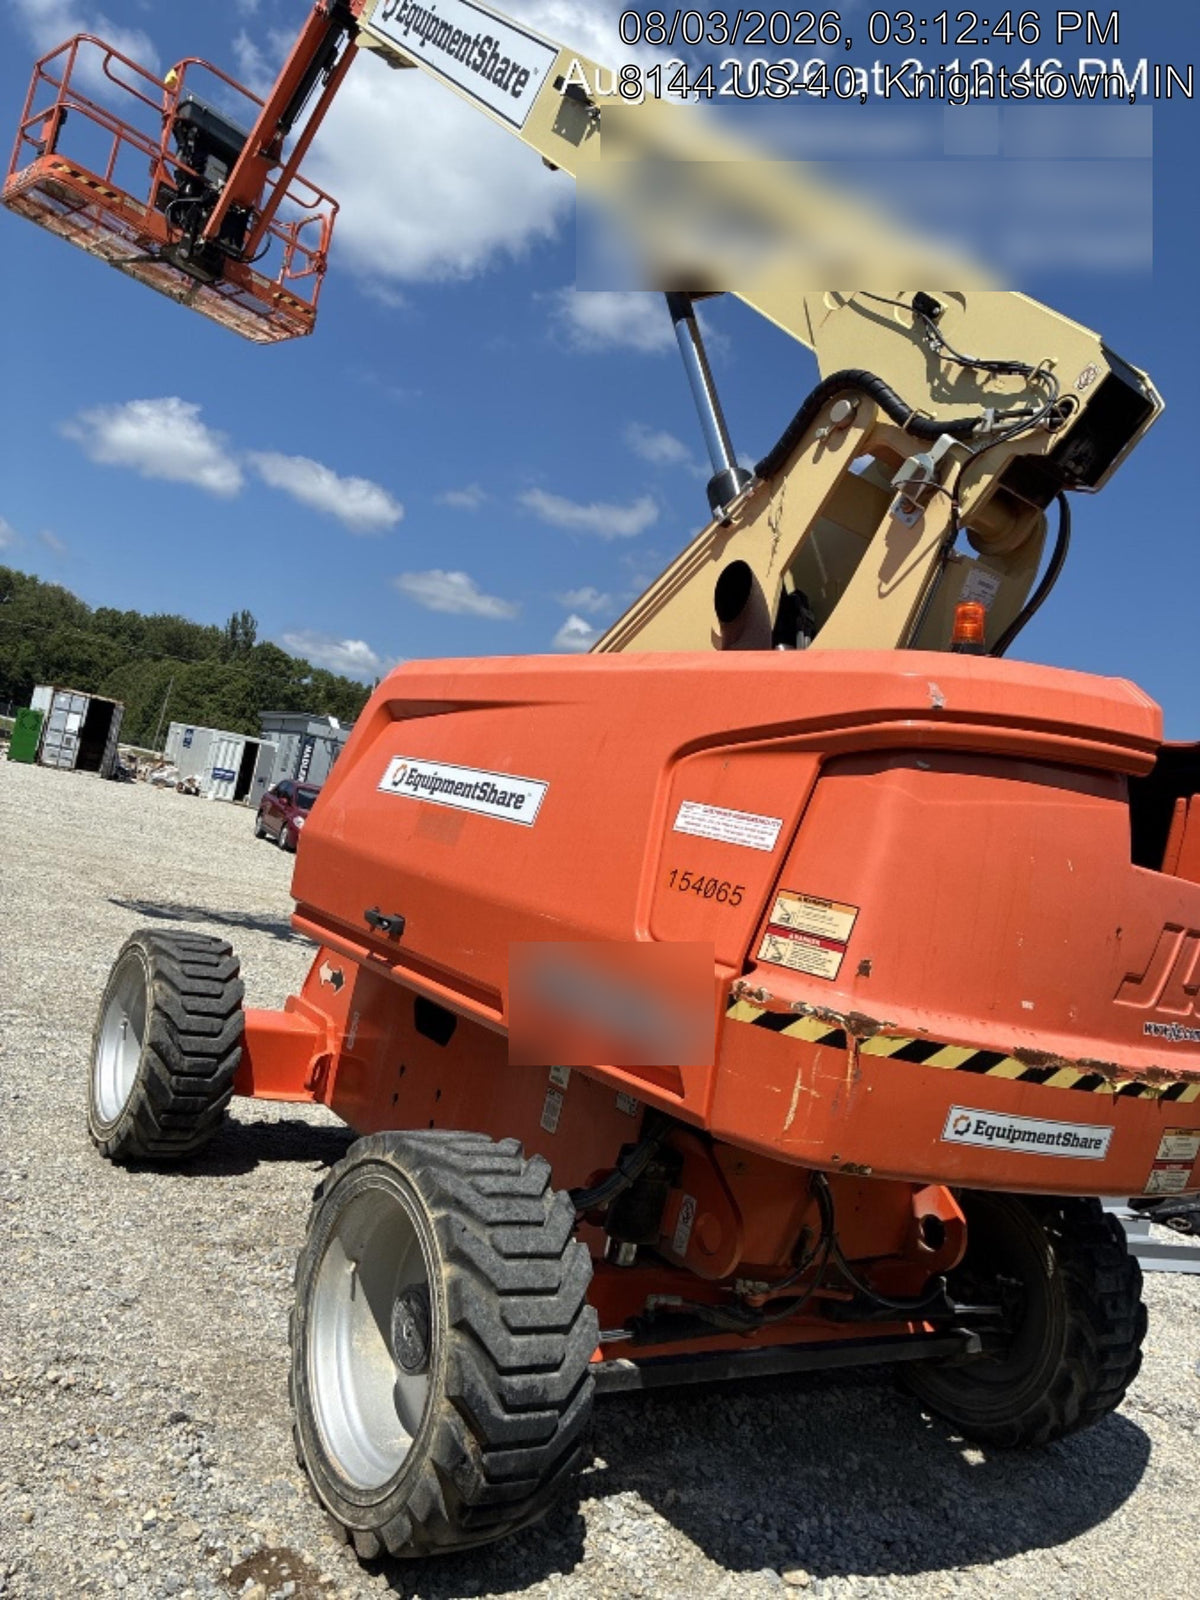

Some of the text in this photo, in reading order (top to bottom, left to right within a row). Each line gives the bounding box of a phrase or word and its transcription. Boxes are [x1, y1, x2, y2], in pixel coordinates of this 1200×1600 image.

[394, 0, 531, 99] EquipmentShare
[405, 767, 526, 810] EquipmentShare
[668, 868, 746, 906] 154065
[1113, 922, 1200, 1016] JL
[972, 1119, 1104, 1150] EquipmentShare
